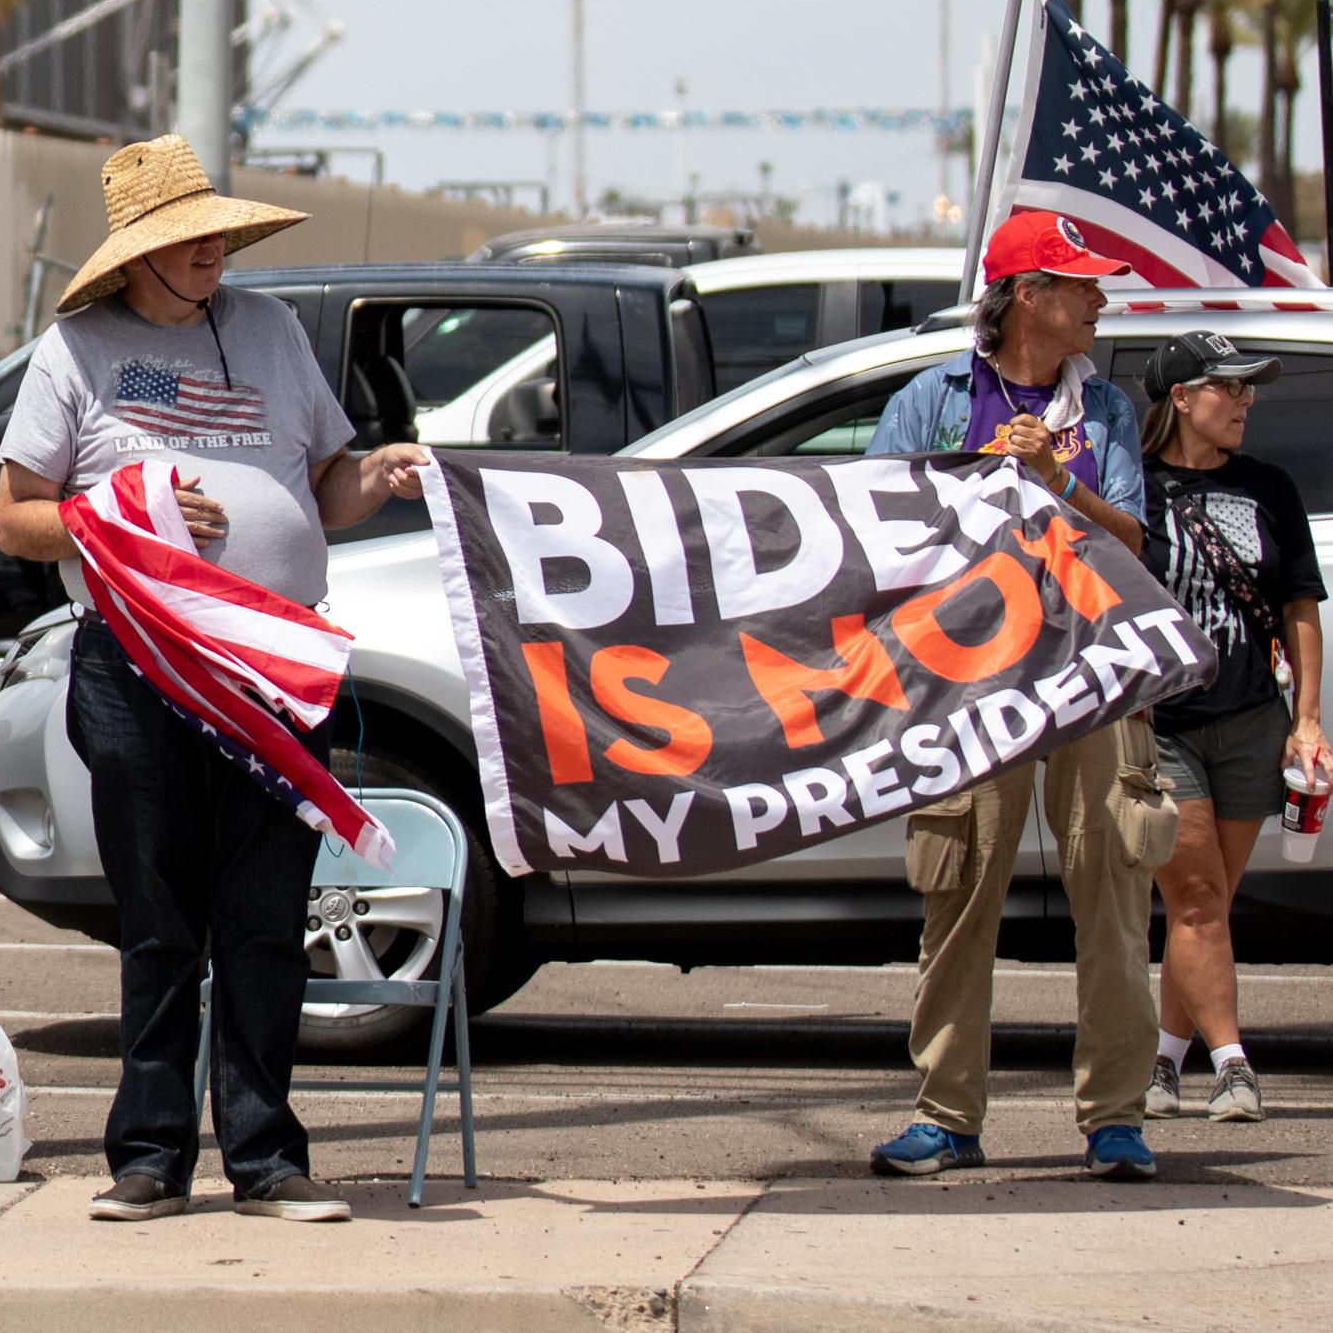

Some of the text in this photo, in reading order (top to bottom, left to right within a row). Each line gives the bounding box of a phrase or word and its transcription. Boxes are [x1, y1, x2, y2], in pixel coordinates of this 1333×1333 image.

[114, 432, 272, 453] LAND OF THE FREE
[481, 460, 1059, 630] BIDEN
[522, 516, 1123, 785] IS NOT
[544, 607, 1200, 864] MY PRESIDENT
